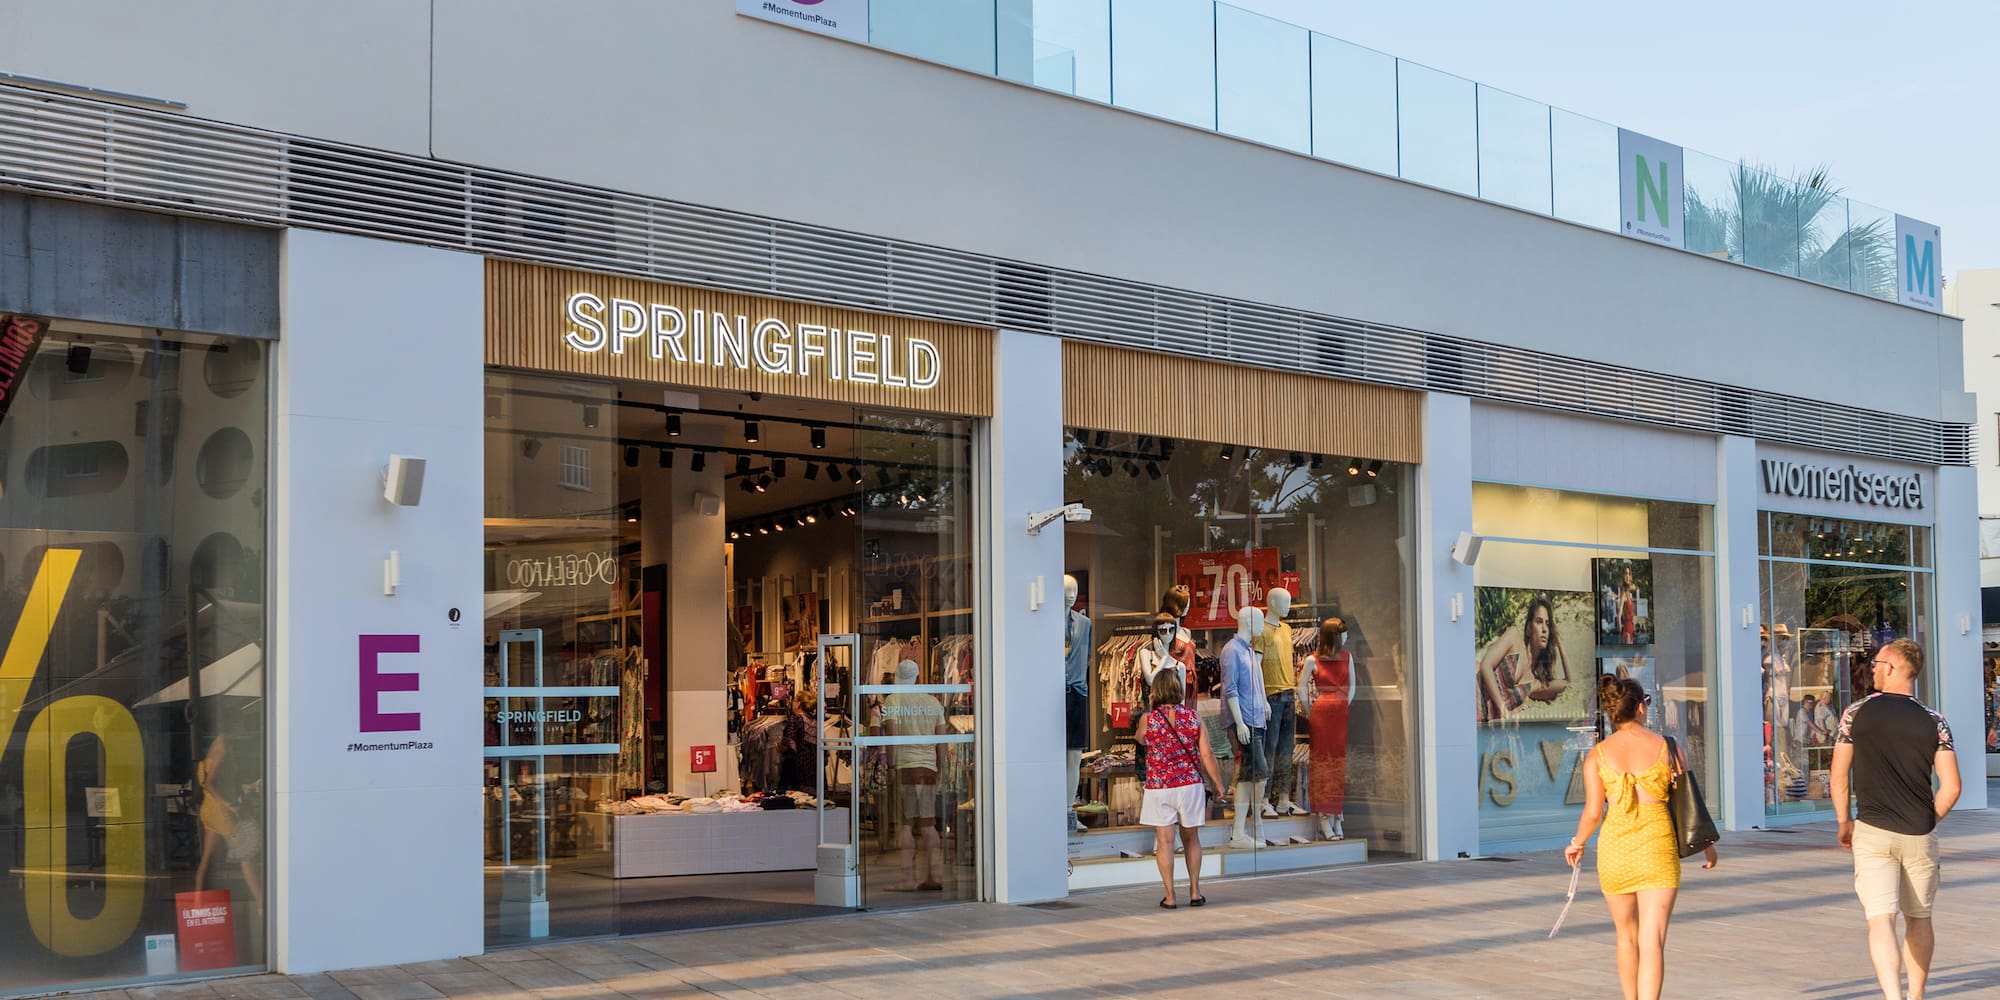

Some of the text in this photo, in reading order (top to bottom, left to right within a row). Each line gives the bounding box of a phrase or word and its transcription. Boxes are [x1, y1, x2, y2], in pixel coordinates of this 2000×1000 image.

[762, 2, 837, 28] #MomentumPlaza
[1636, 154, 1669, 228] N
[1906, 234, 1934, 298] M
[564, 292, 941, 390] SPRINGFIELD
[359, 634, 421, 733] E
[496, 710, 581, 724] SPRINGFIELD
[880, 706, 945, 717] SPRINGFIELD
[347, 740, 434, 752] #MomentumPlaza
